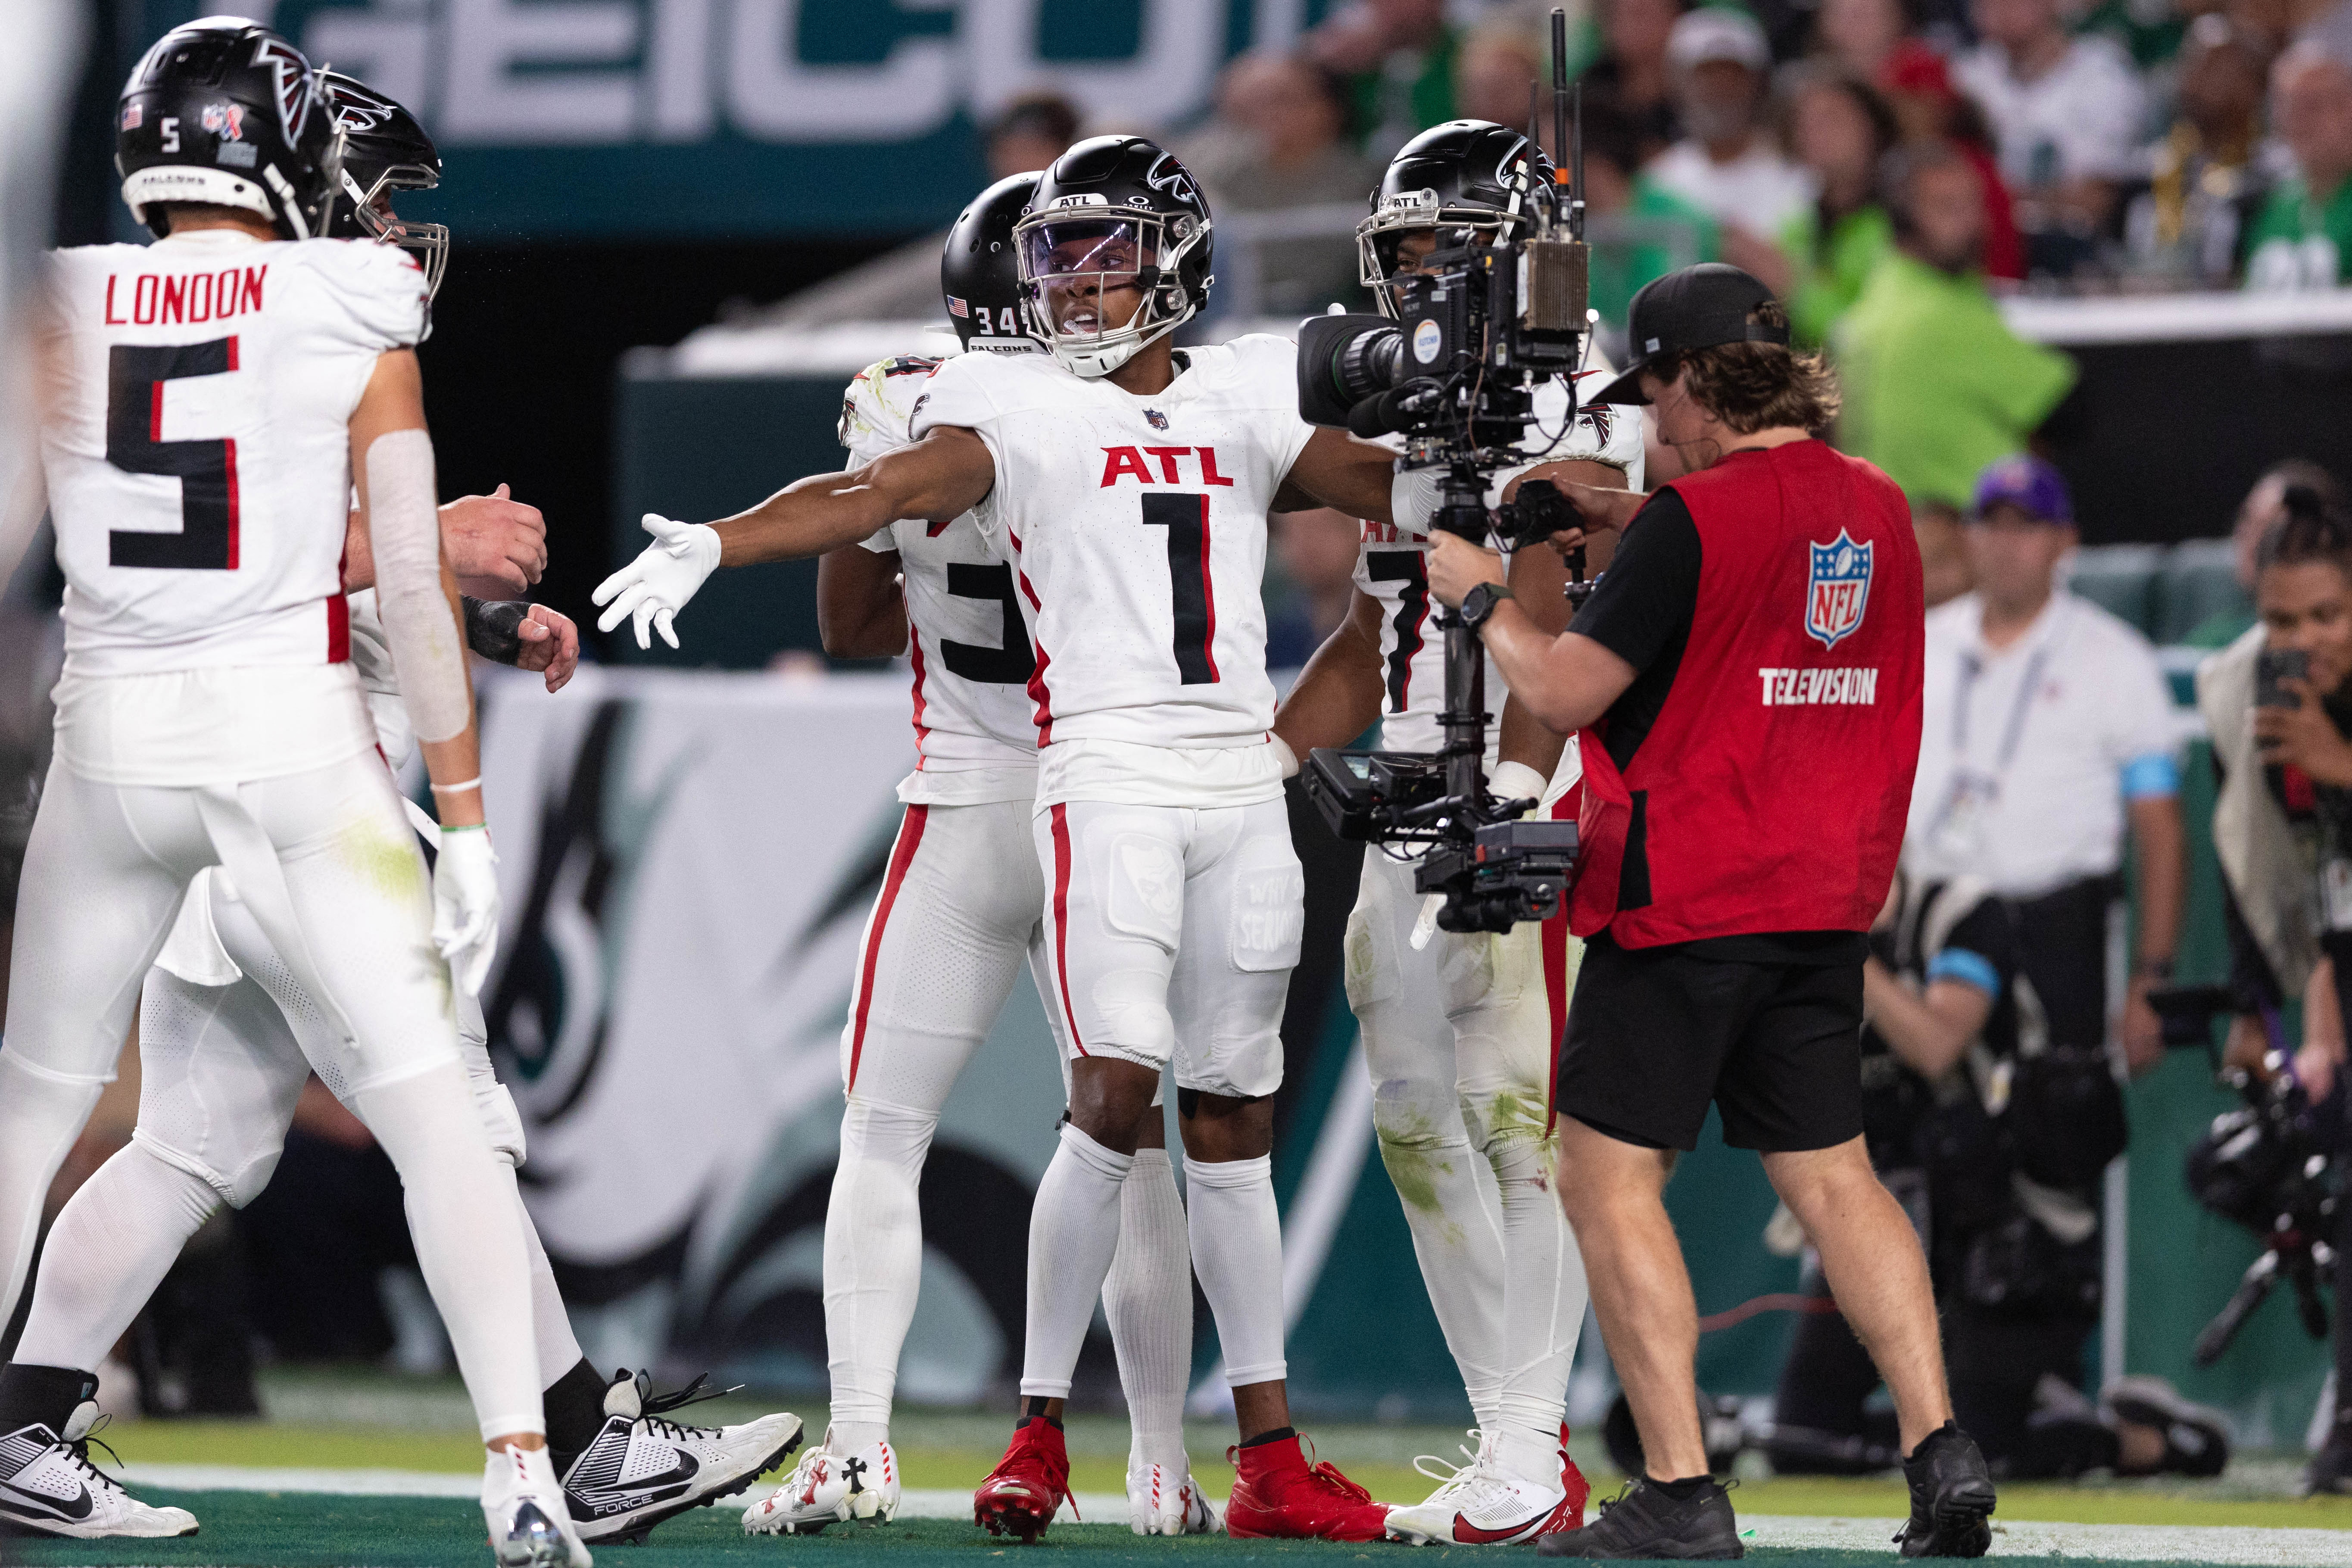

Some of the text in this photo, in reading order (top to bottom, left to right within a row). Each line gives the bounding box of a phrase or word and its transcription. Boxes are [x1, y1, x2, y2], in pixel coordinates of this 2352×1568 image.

[202, 0, 1224, 144] GEICO
[161, 118, 180, 153] 5
[1060, 196, 1091, 208] ATL
[1394, 197, 1421, 207] ATL
[106, 264, 267, 325] LONDON
[975, 307, 1018, 335] 34
[1151, 416, 1166, 427] NFL
[106, 335, 240, 570] 5
[1100, 446, 1234, 487] ATL
[1142, 493, 1220, 685] 1
[1814, 583, 1857, 631] NFL
[1367, 550, 1431, 714] 7
[1758, 667, 1878, 707] TELEVISION
[1249, 875, 1290, 907] WHY
[594, 1493, 654, 1515] FORCE
